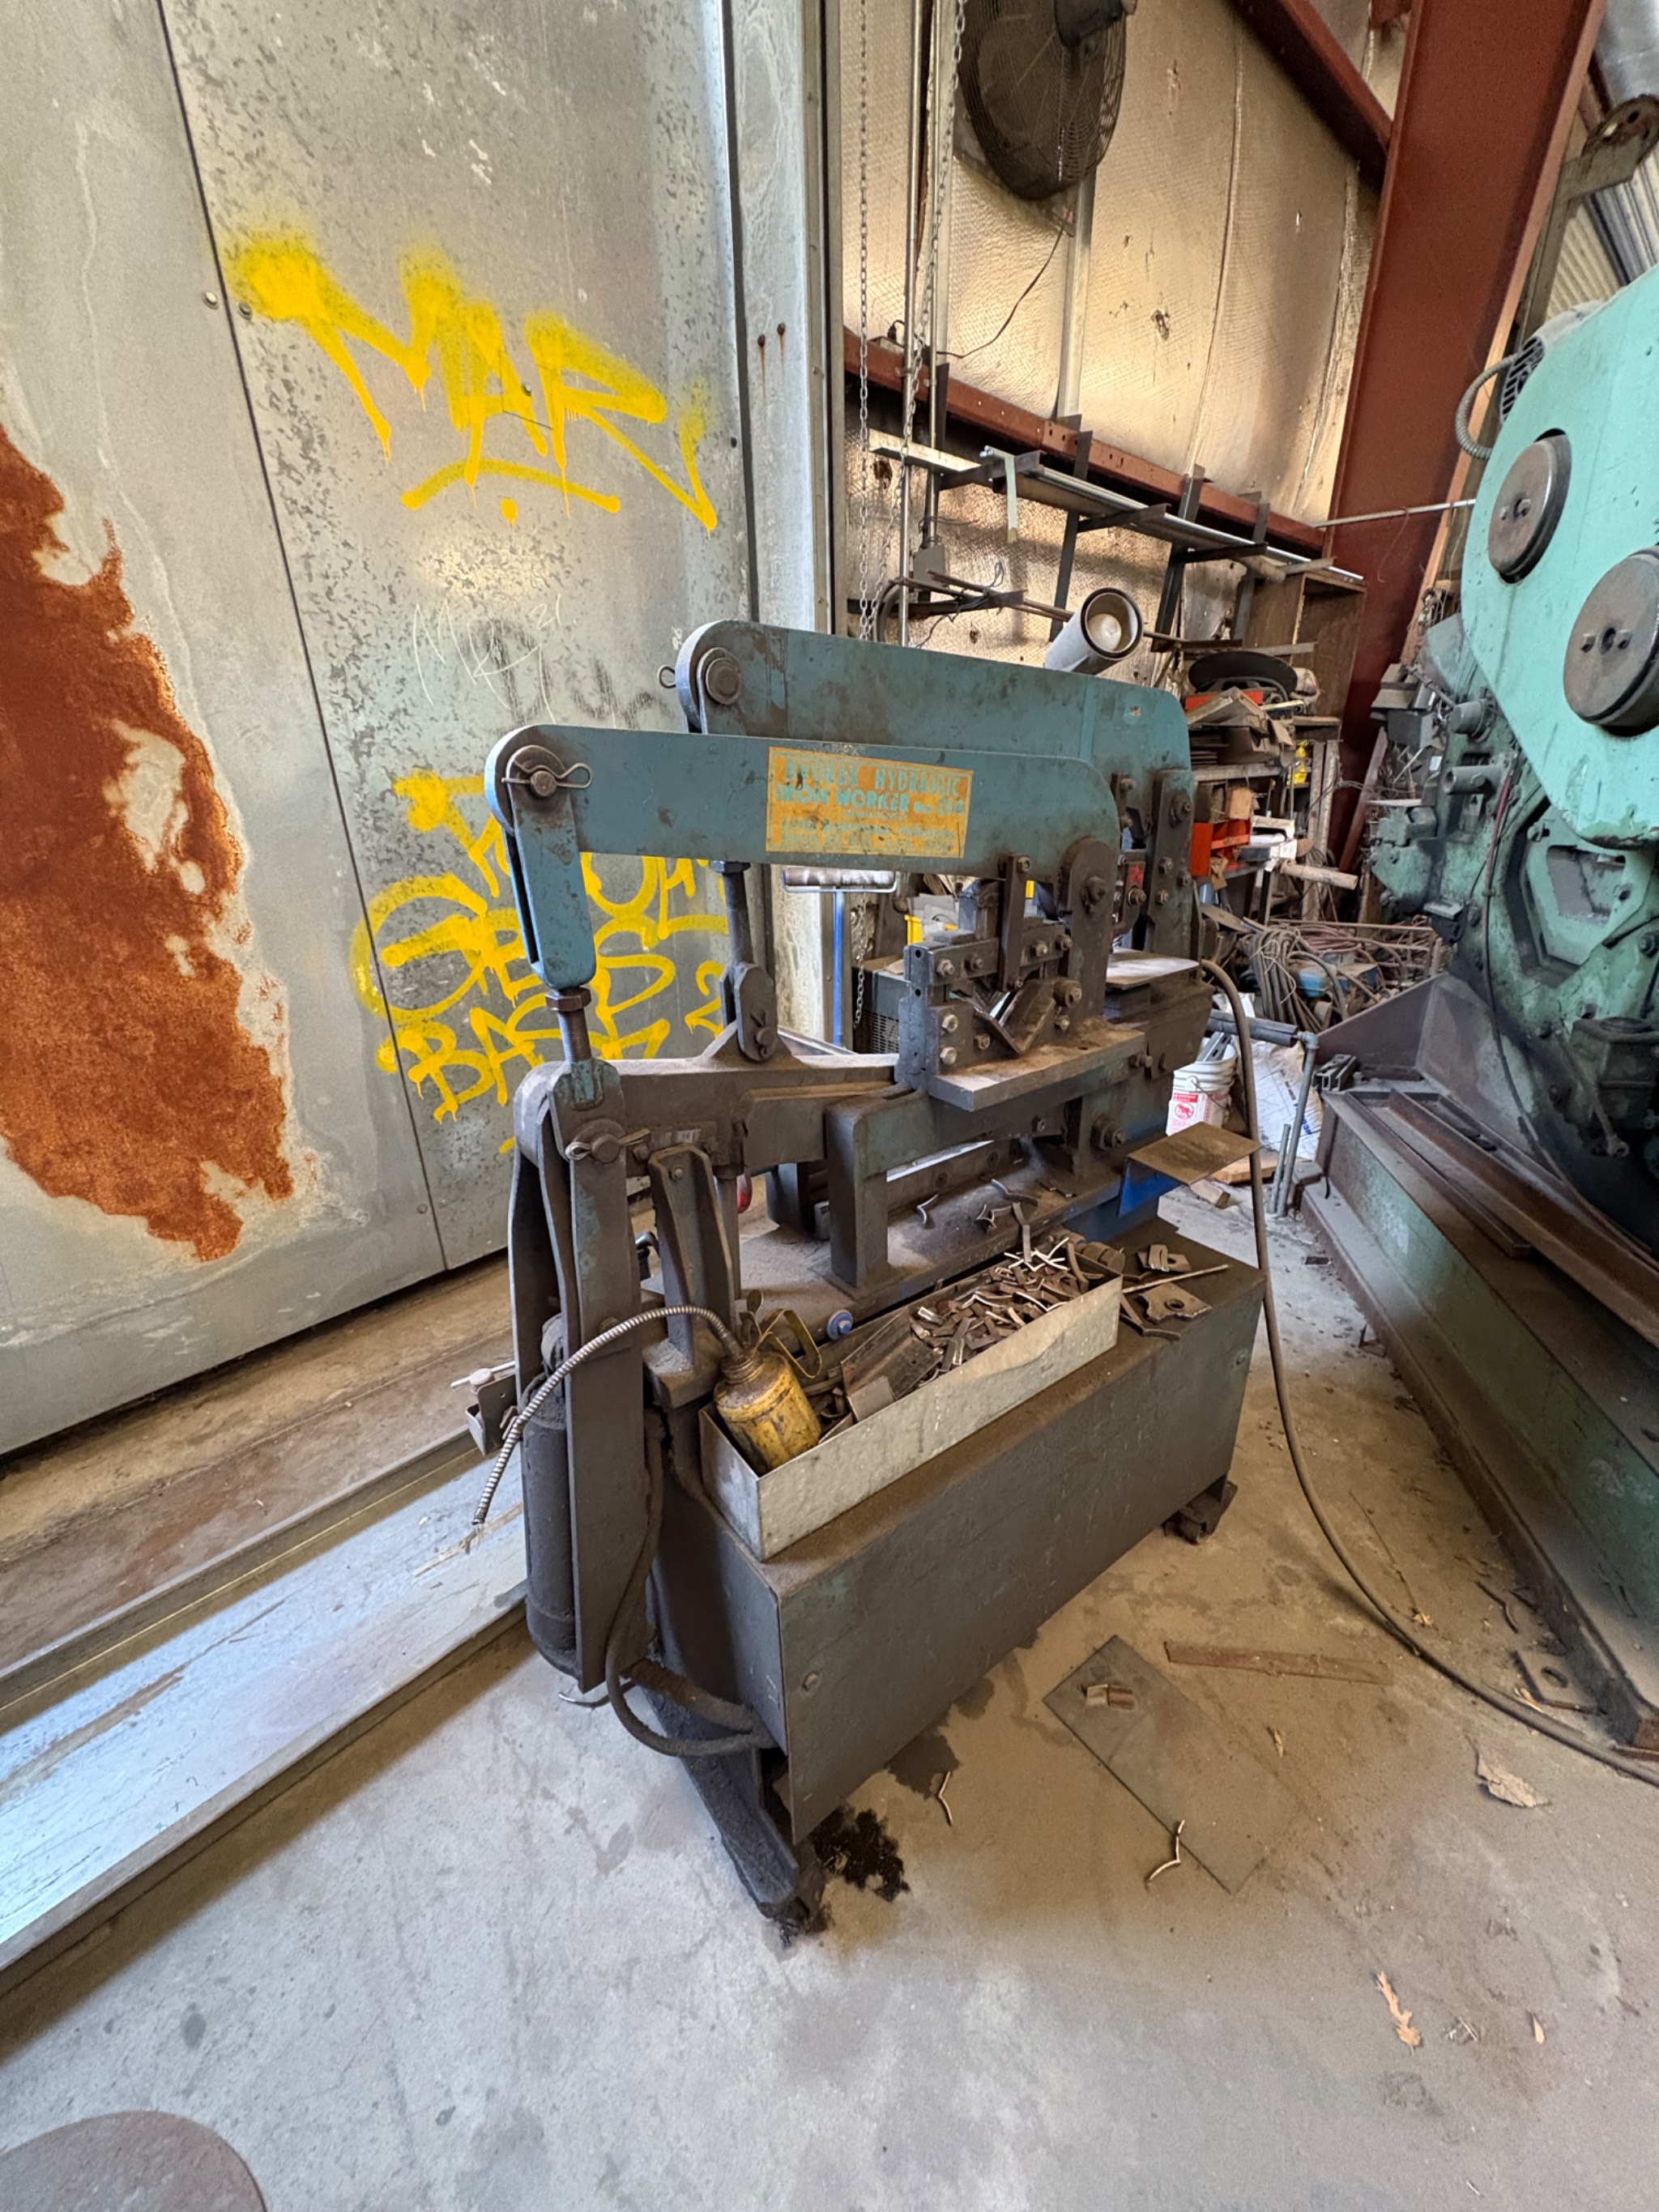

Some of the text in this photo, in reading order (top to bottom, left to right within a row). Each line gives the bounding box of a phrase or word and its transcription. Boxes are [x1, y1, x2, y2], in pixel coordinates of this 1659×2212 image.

[785, 757, 962, 798] DVORAK HYDRAULIC
[776, 782, 830, 804] IRON
[836, 789, 911, 812] WORKER
